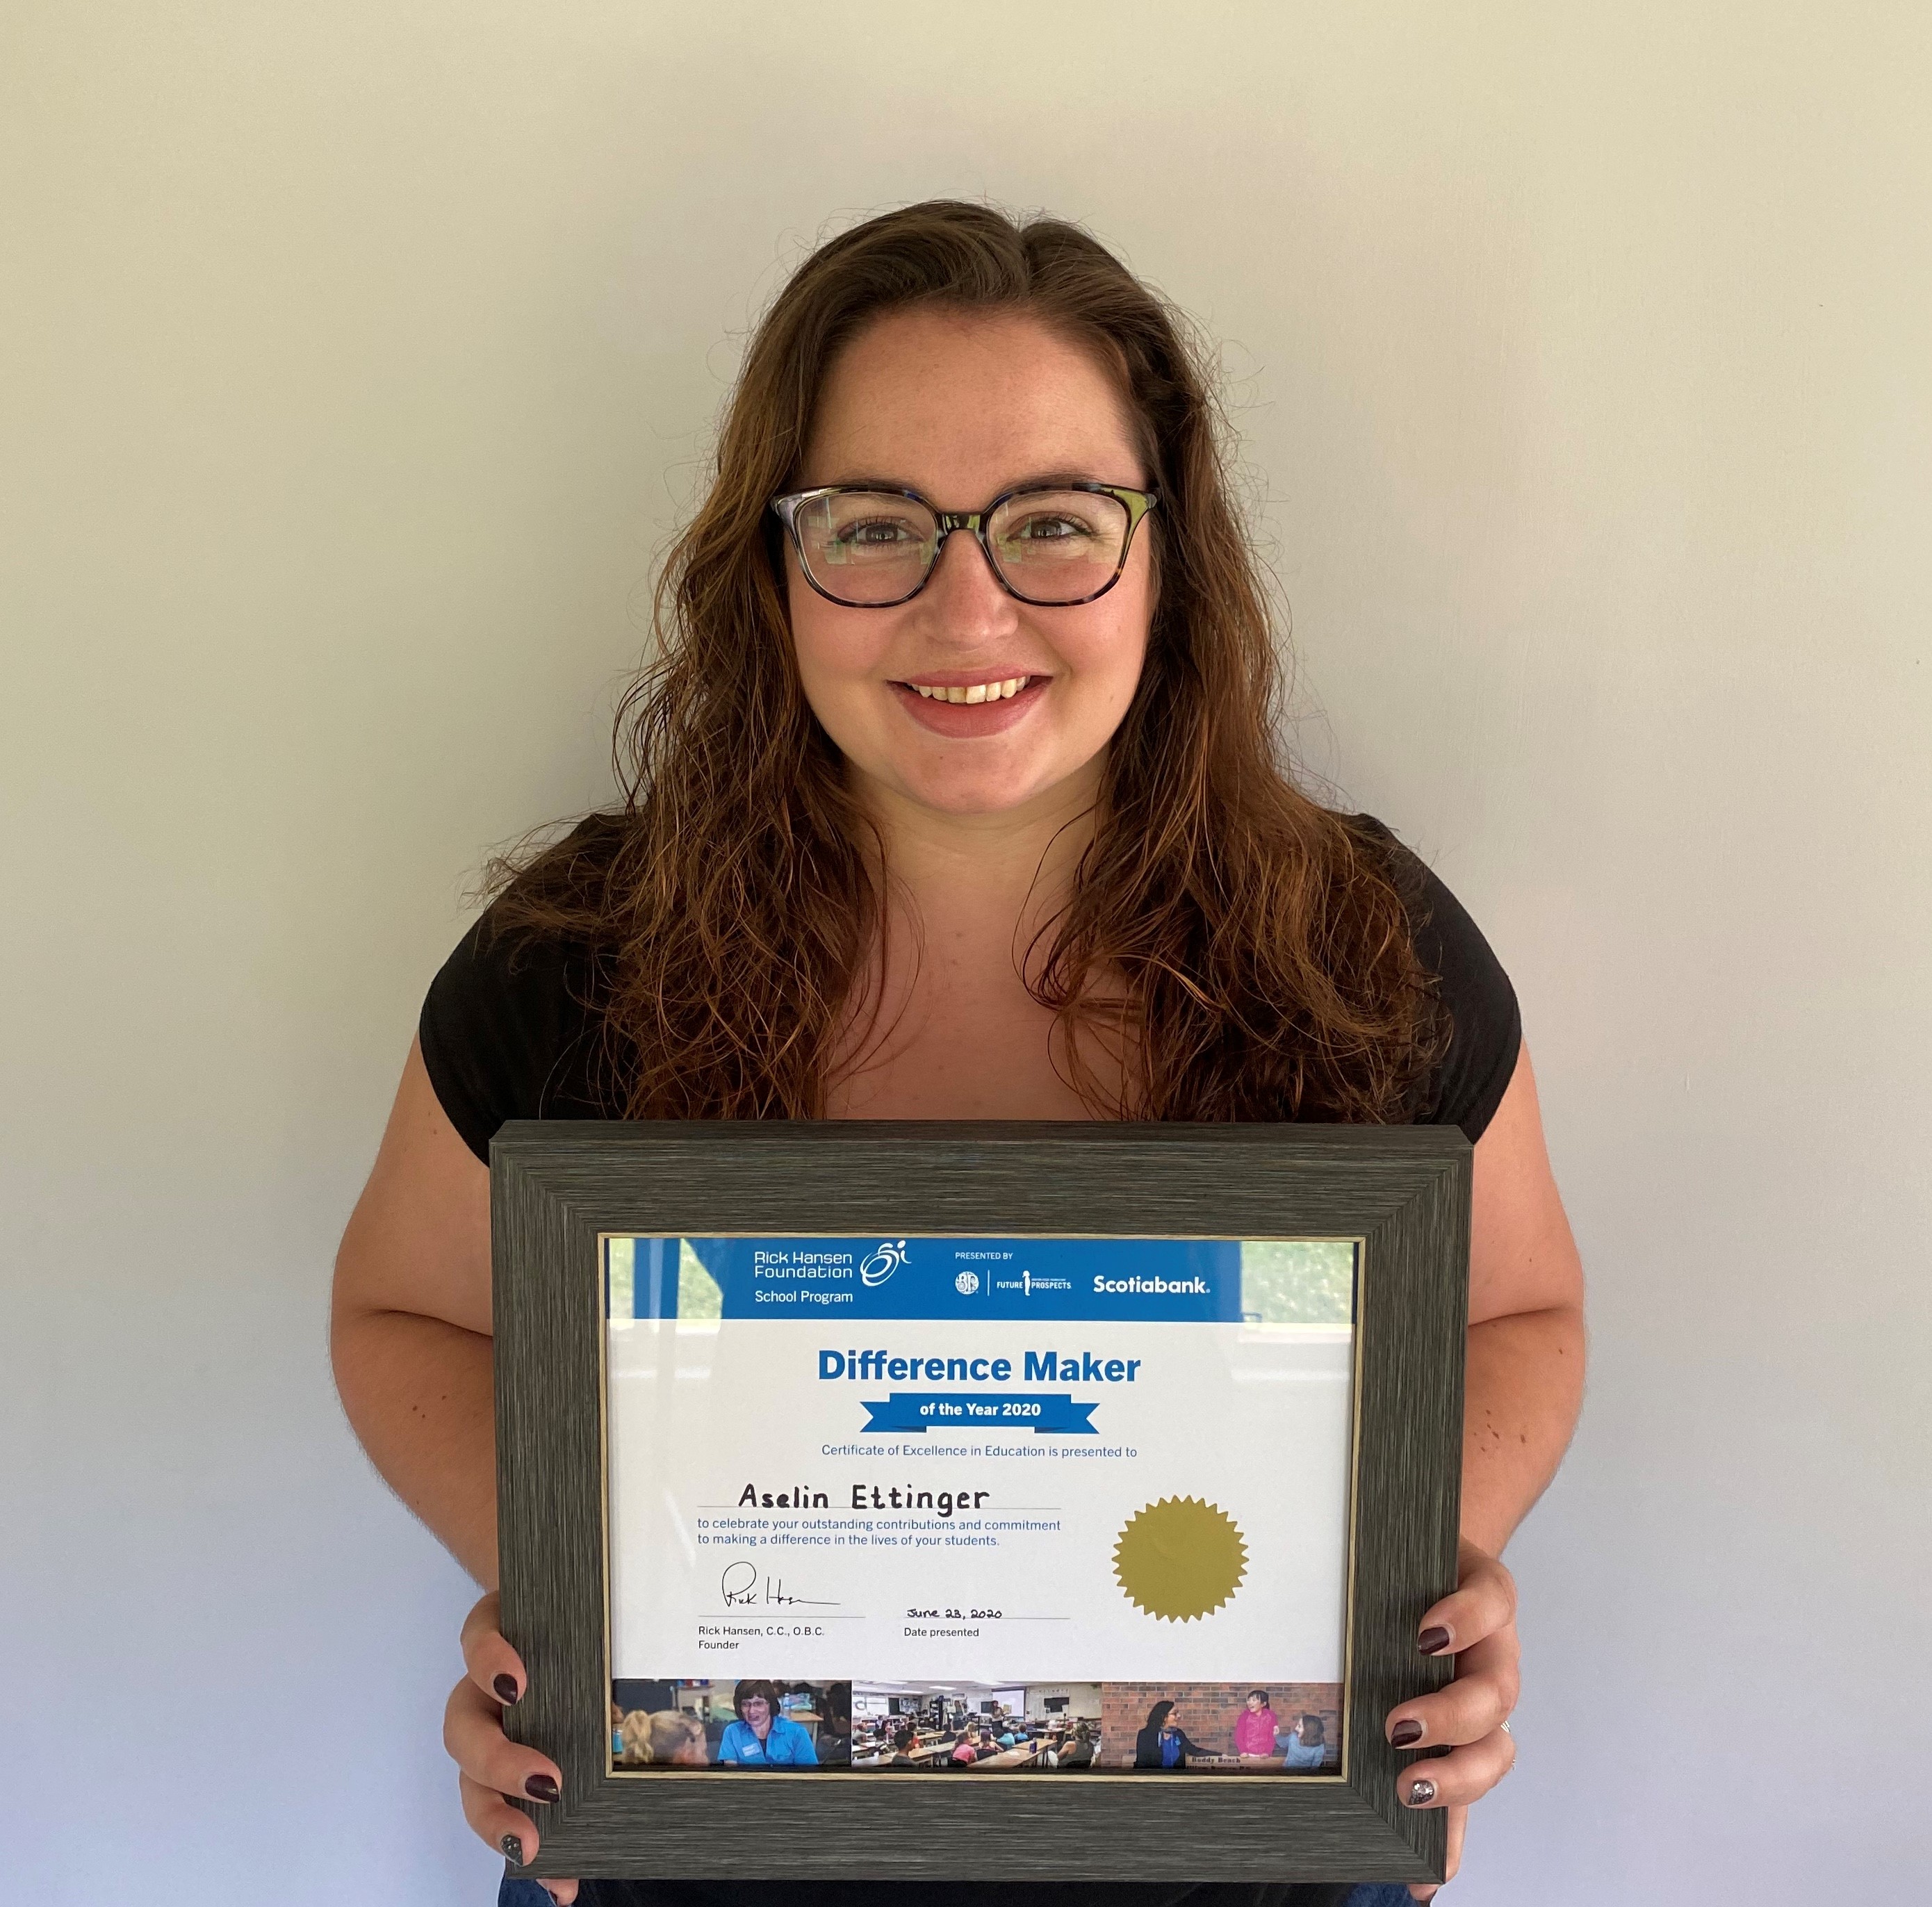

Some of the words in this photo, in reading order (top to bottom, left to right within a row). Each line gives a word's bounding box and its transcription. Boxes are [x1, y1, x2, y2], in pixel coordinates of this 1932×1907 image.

[755, 1251, 788, 1264] Rick
[792, 1251, 853, 1264] Hansen
[955, 1252, 1001, 1260] PRESENTED
[1003, 1252, 1013, 1260] BY
[755, 1265, 853, 1279] Foundation
[997, 1281, 1023, 1289] FUTURE
[1093, 1275, 1206, 1294] Scotiabank
[755, 1290, 797, 1302] School
[801, 1290, 853, 1305] Program
[819, 1349, 1012, 1382] Difference
[1024, 1351, 1141, 1382] Maker
[919, 1402, 936, 1416] of
[938, 1402, 963, 1416] the
[965, 1402, 999, 1416] Year
[1002, 1402, 1042, 1416] 2020
[822, 1445, 885, 1456] Certificate
[888, 1444, 900, 1456] of
[903, 1445, 967, 1456] Excellence
[971, 1446, 981, 1456] in
[985, 1445, 1045, 1457] Education
[1049, 1446, 1058, 1457] is
[1062, 1446, 1121, 1459] presented
[1125, 1447, 1138, 1457] to
[738, 1483, 829, 1509] Aselin
[851, 1483, 990, 1518] Ettinger
[697, 1518, 710, 1529] to
[712, 1517, 769, 1529] celebrate
[772, 1520, 799, 1531] your
[801, 1519, 874, 1532] outstanding
[876, 1519, 956, 1530] contributions
[958, 1519, 981, 1530] and
[984, 1519, 1061, 1531] commitment
[697, 1534, 710, 1544] to
[712, 1533, 757, 1547] making
[760, 1536, 767, 1545] a
[770, 1533, 831, 1545] difference
[834, 1534, 845, 1545] in
[848, 1534, 868, 1545] the
[871, 1534, 898, 1546] lives
[901, 1534, 912, 1546] of
[915, 1537, 942, 1548] your
[944, 1534, 1000, 1546] students.
[907, 1608, 940, 1619] June
[970, 1609, 1003, 1619] 2020
[698, 1626, 721, 1636] Rick
[723, 1626, 763, 1637] Hansen,
[766, 1626, 790, 1637] C.C.,
[793, 1626, 825, 1636] O.B.C.
[903, 1627, 927, 1637] Date
[930, 1627, 979, 1639] presented
[698, 1639, 740, 1650] Founder
